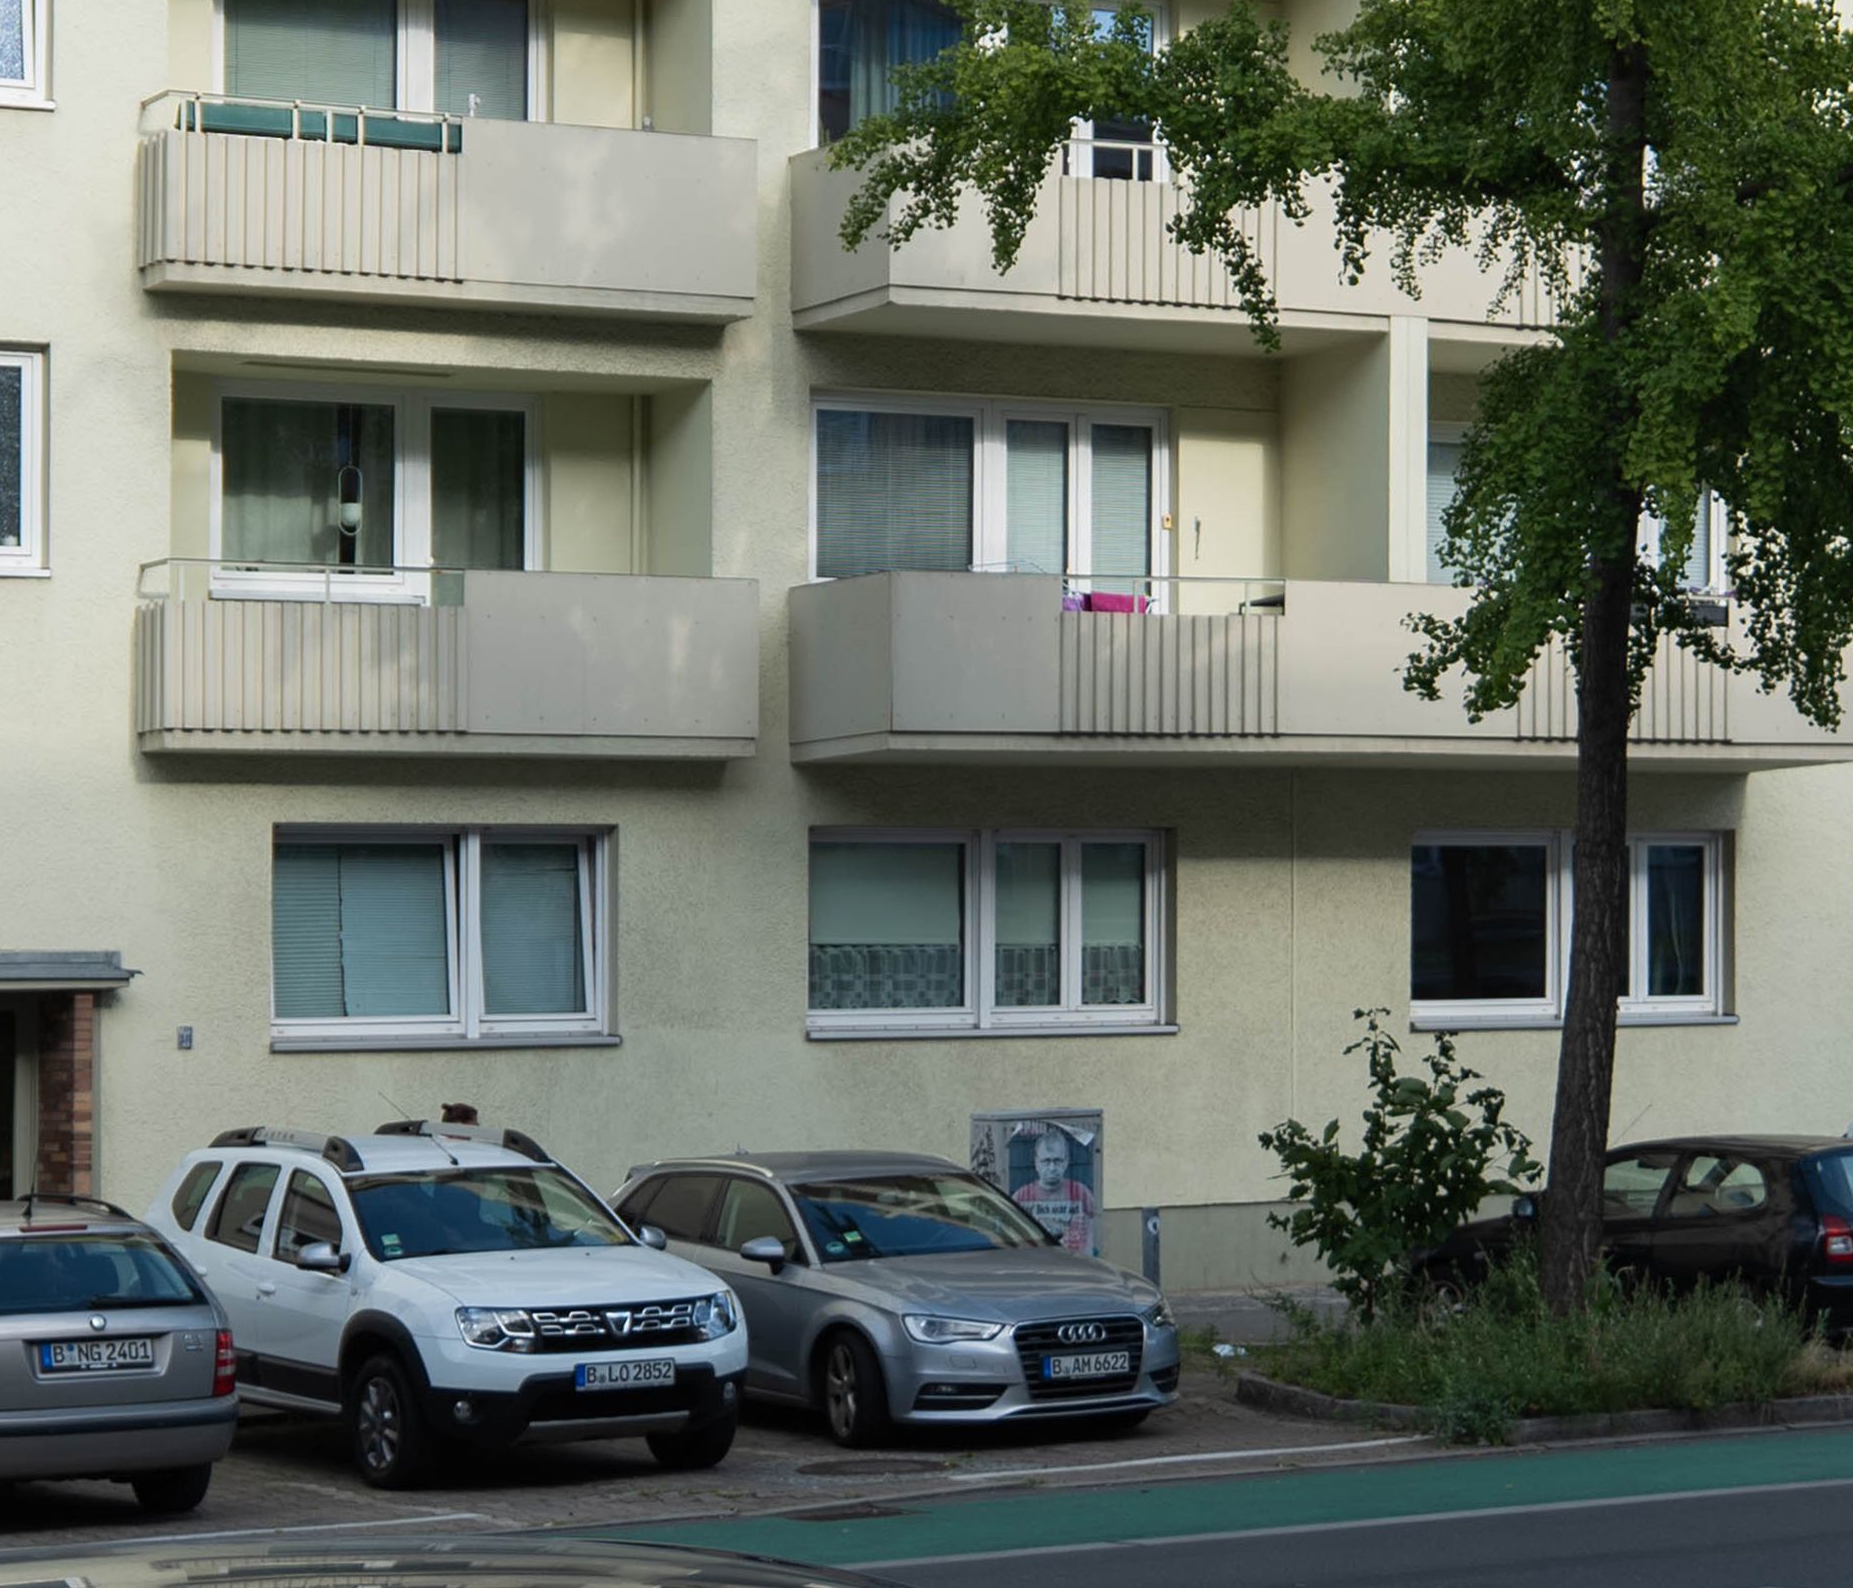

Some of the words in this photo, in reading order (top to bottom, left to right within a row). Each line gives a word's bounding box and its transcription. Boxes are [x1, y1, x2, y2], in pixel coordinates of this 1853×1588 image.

[53, 1344, 65, 1363] B
[78, 1342, 101, 1362] NG
[106, 1340, 150, 1361] 2401
[587, 1366, 597, 1384] B
[608, 1364, 630, 1383] LO
[633, 1361, 672, 1381] 2852
[1053, 1358, 1062, 1375] B
[1072, 1356, 1091, 1373] AM
[1094, 1353, 1127, 1372] 6622
